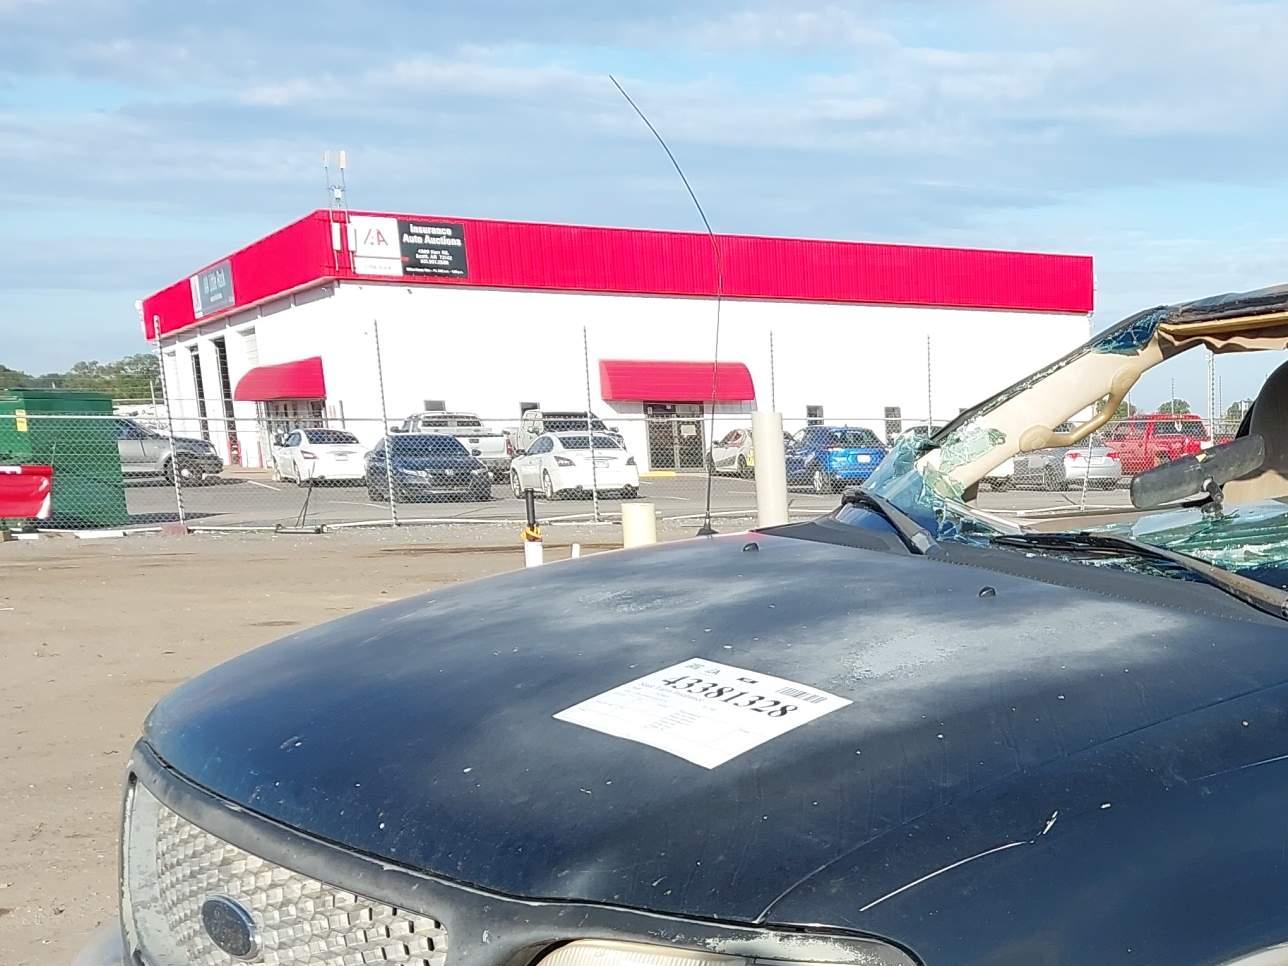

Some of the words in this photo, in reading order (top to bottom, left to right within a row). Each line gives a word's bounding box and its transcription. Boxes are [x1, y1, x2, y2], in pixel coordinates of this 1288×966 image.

[409, 223, 452, 236] Insurance
[402, 233, 424, 244] Auto
[424, 234, 462, 247] Auctions
[661, 675, 798, 718] 43381328
